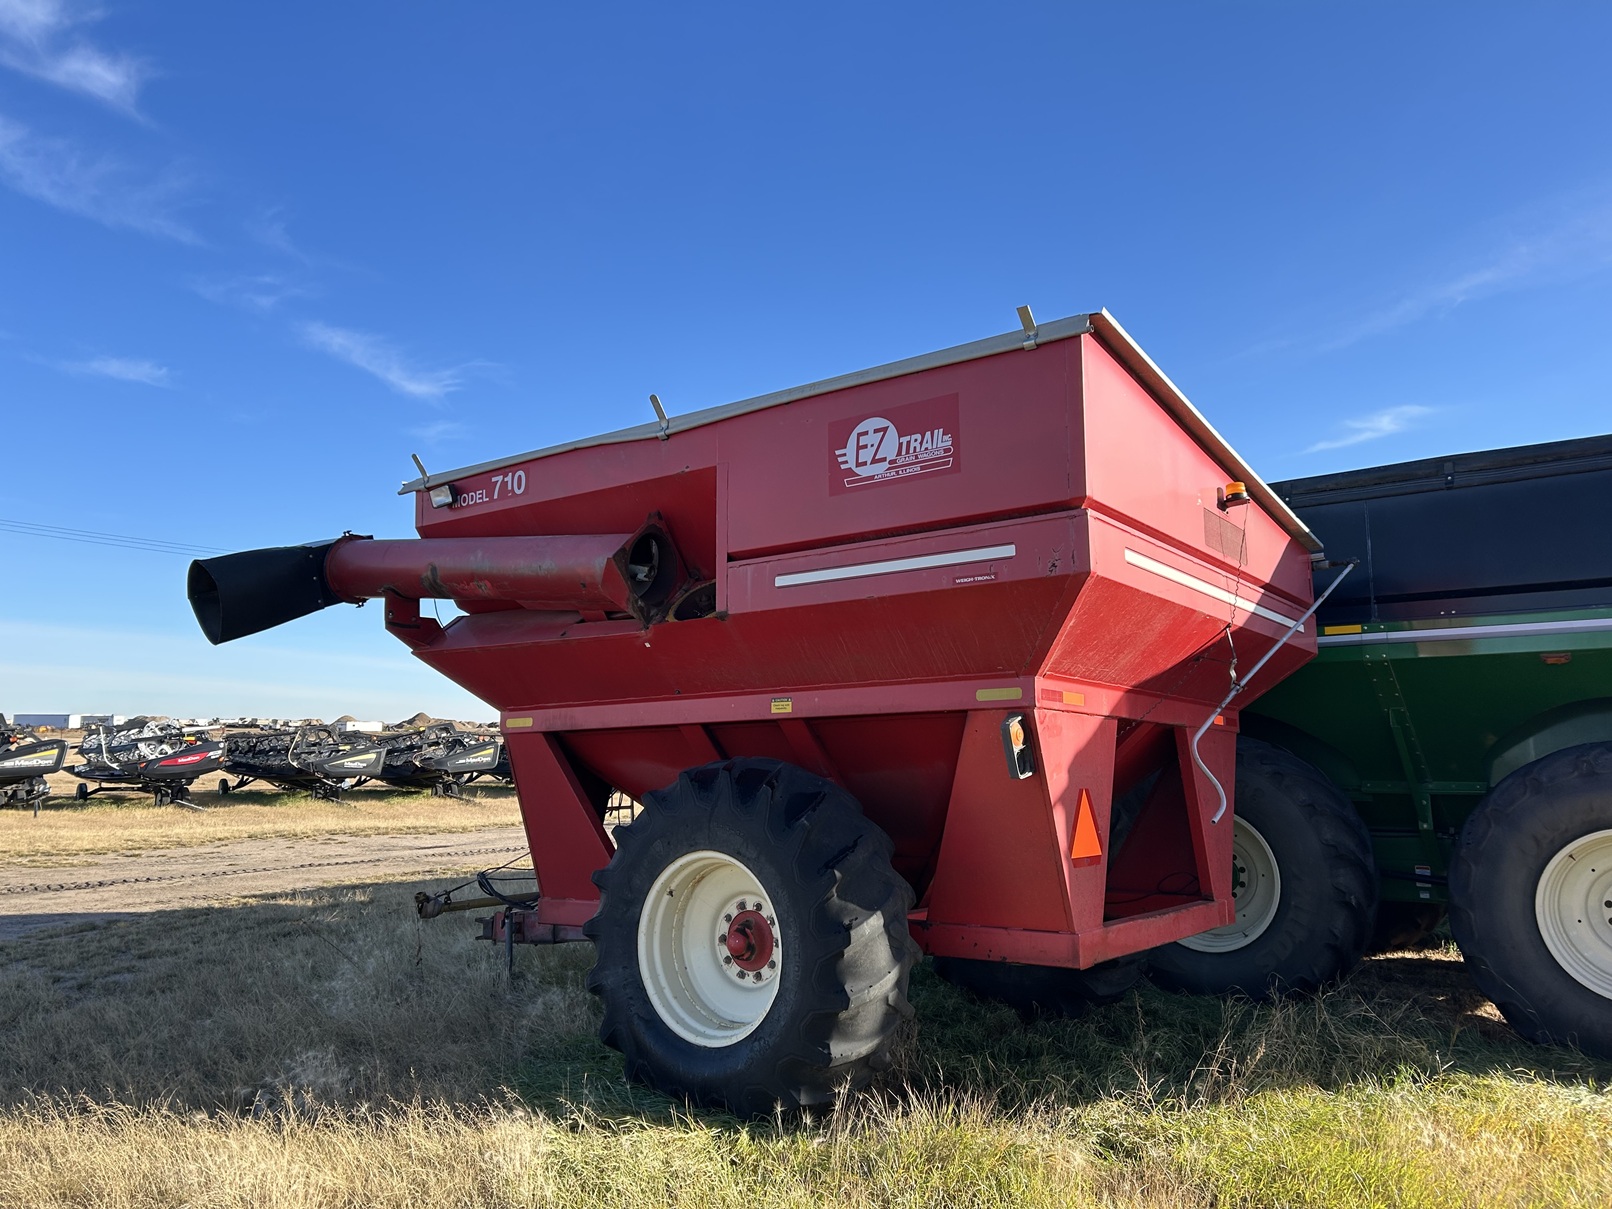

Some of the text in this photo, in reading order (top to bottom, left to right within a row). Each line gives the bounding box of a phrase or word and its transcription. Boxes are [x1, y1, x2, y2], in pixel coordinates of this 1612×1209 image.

[900, 428, 952, 456] TRAIL
[897, 450, 945, 464] GRAIN WAGONS
[899, 466, 921, 475] ILLINOIS
[491, 470, 526, 499] 710
